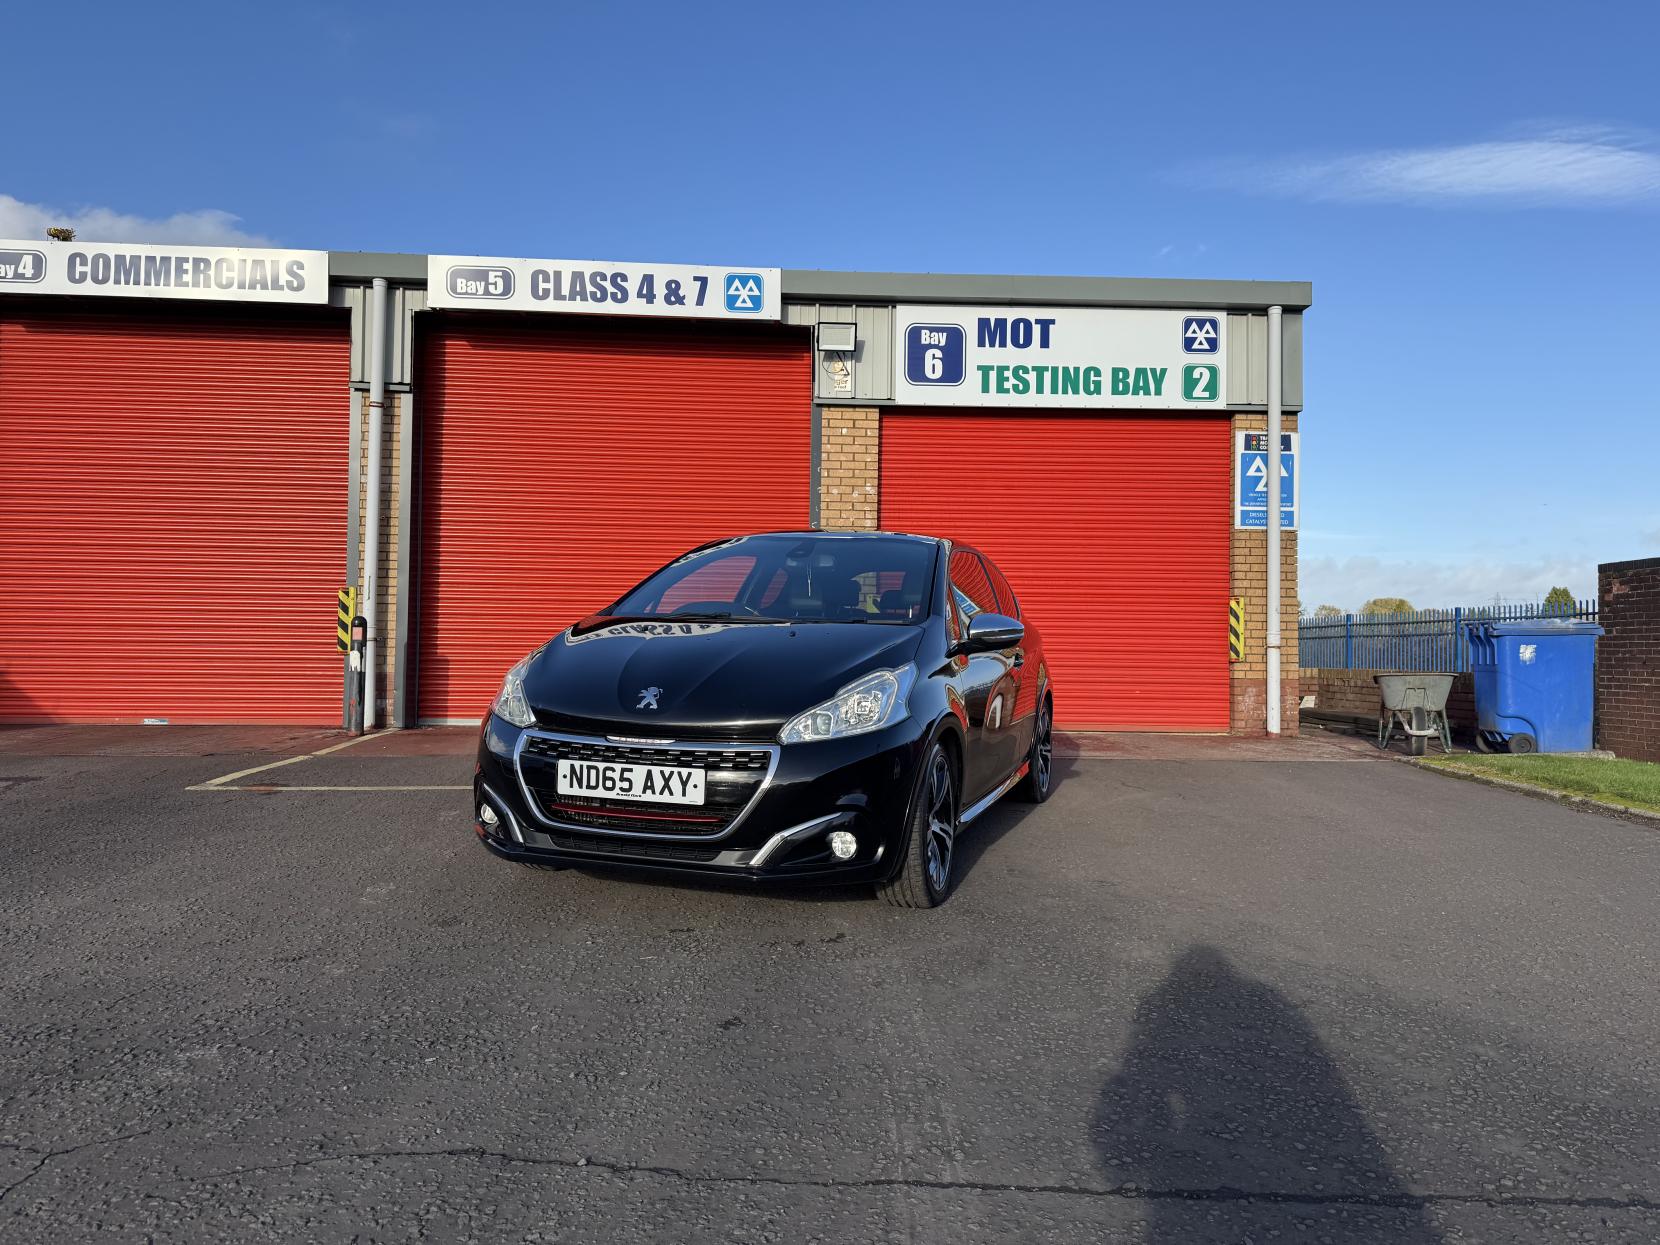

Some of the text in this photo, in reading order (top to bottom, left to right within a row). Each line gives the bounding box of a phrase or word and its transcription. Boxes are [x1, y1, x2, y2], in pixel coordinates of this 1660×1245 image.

[0, 254, 34, 278] ay 4
[67, 252, 305, 292] COMMERCIALS
[456, 271, 504, 295] Bay 5
[530, 269, 709, 307] CLASS 4 & 7
[921, 330, 947, 346] Bay
[977, 317, 1056, 349] MOT
[924, 348, 943, 380] 6
[976, 364, 1168, 396] TESTING BAY
[1192, 367, 1210, 398] 2
[569, 763, 693, 798] ND65 AXY
